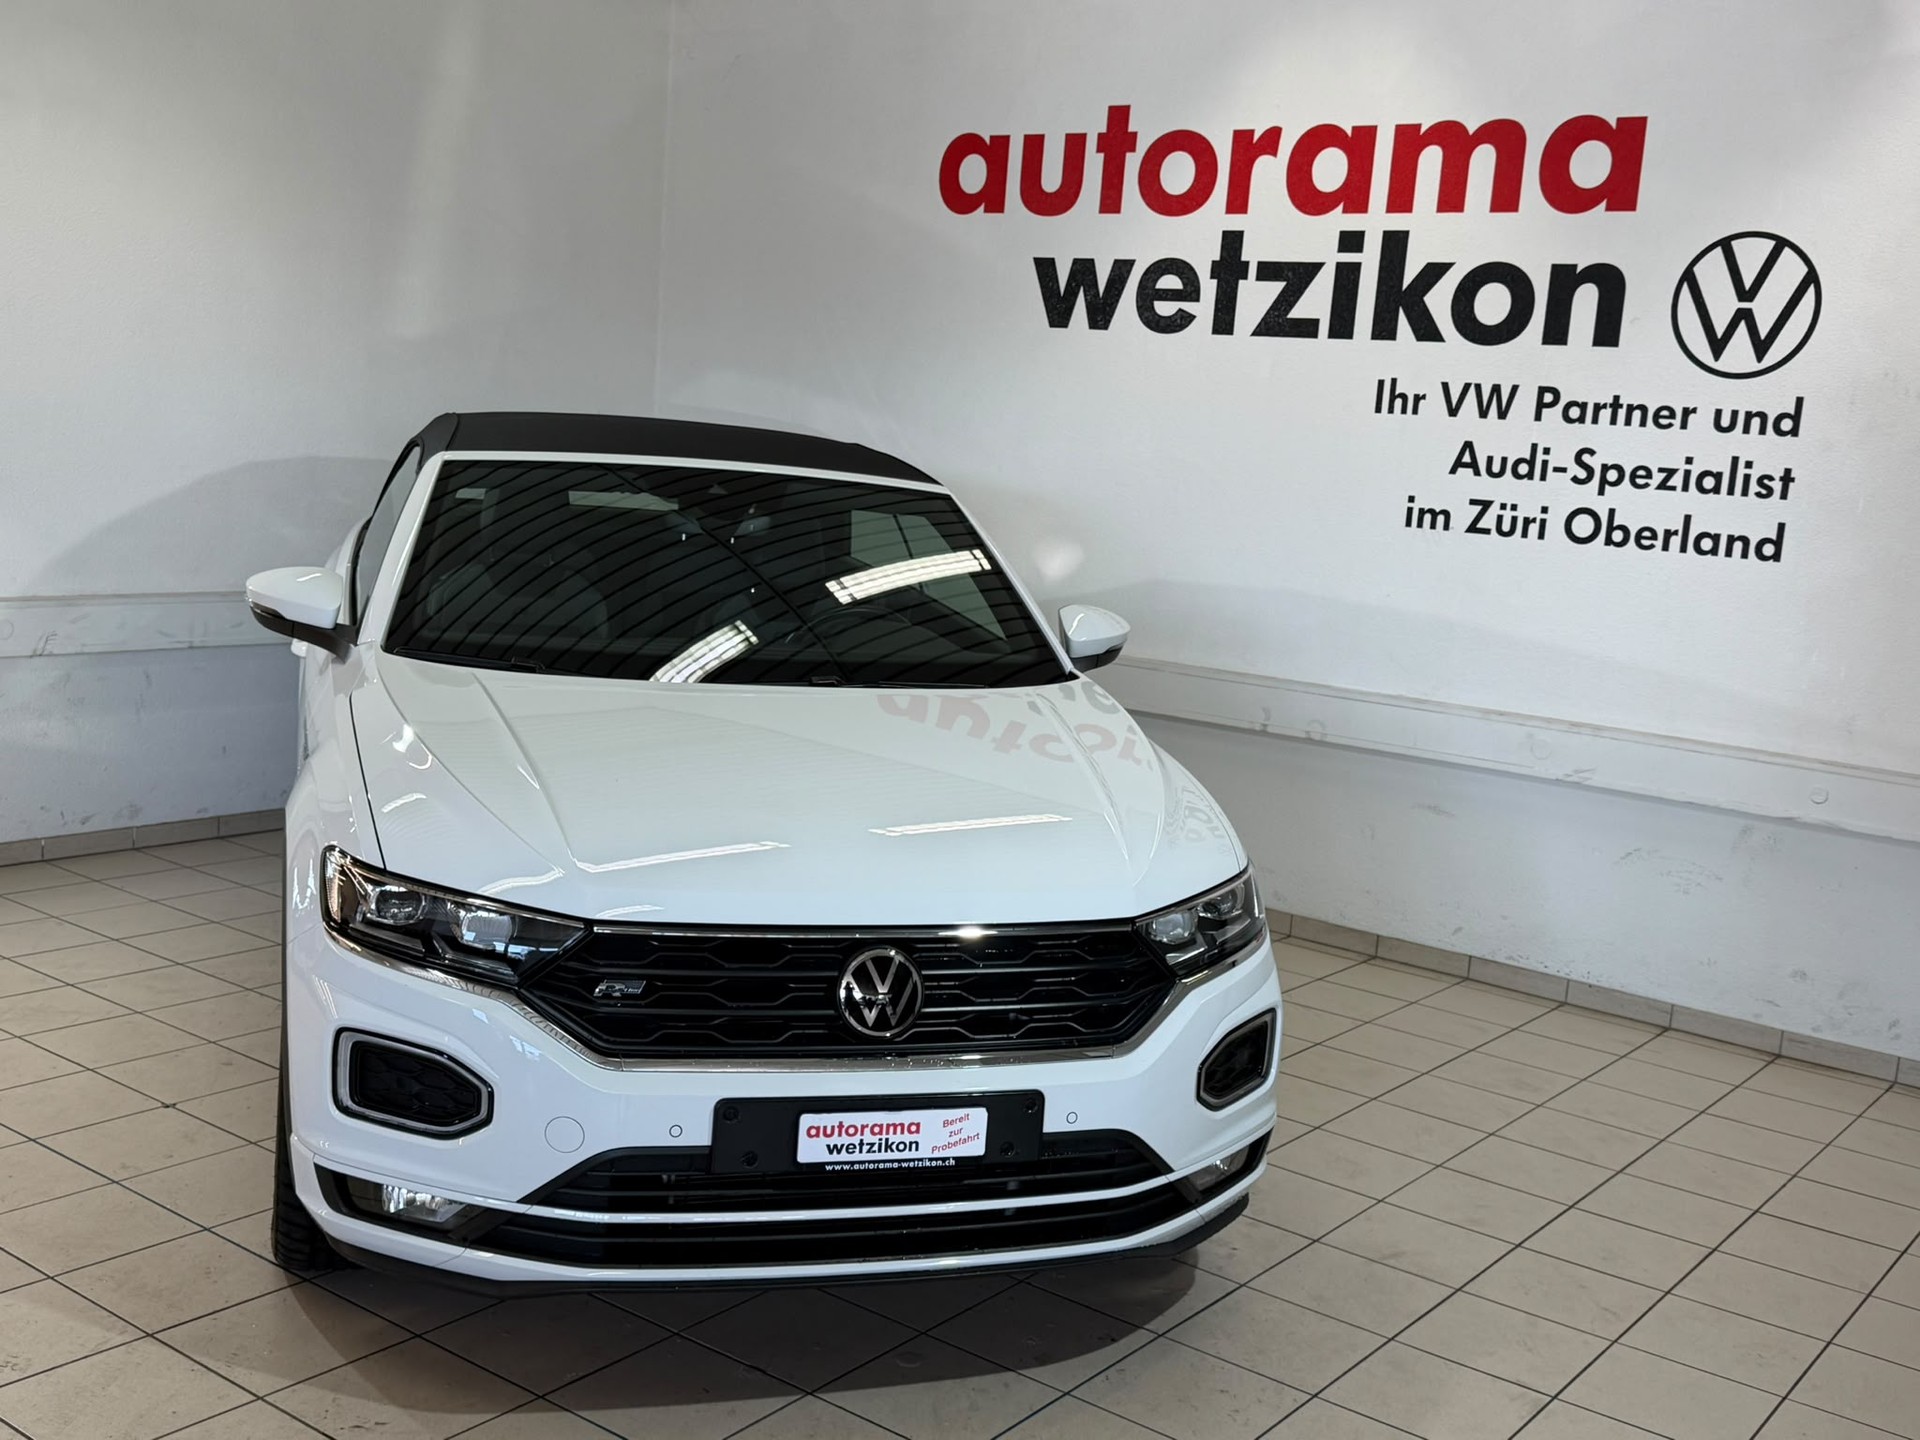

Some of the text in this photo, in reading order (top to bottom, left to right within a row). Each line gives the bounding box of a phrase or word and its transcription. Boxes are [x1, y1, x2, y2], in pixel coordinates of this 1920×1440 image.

[939, 104, 1649, 217] autorama
[1033, 229, 1627, 348] wetzikon
[1374, 377, 1805, 438] Ihr VW Partner und
[1448, 440, 1796, 502] Audi-Spezialist
[1404, 495, 1787, 563] im Züri Oberland
[806, 1120, 920, 1139] autorama
[942, 1113, 970, 1128] Bereit
[931, 1132, 980, 1154] Probefahrt
[948, 1126, 964, 1138] zur
[826, 1138, 919, 1155] wetzikon
[825, 1158, 955, 1171] www.autorama-wetzikon.ch
